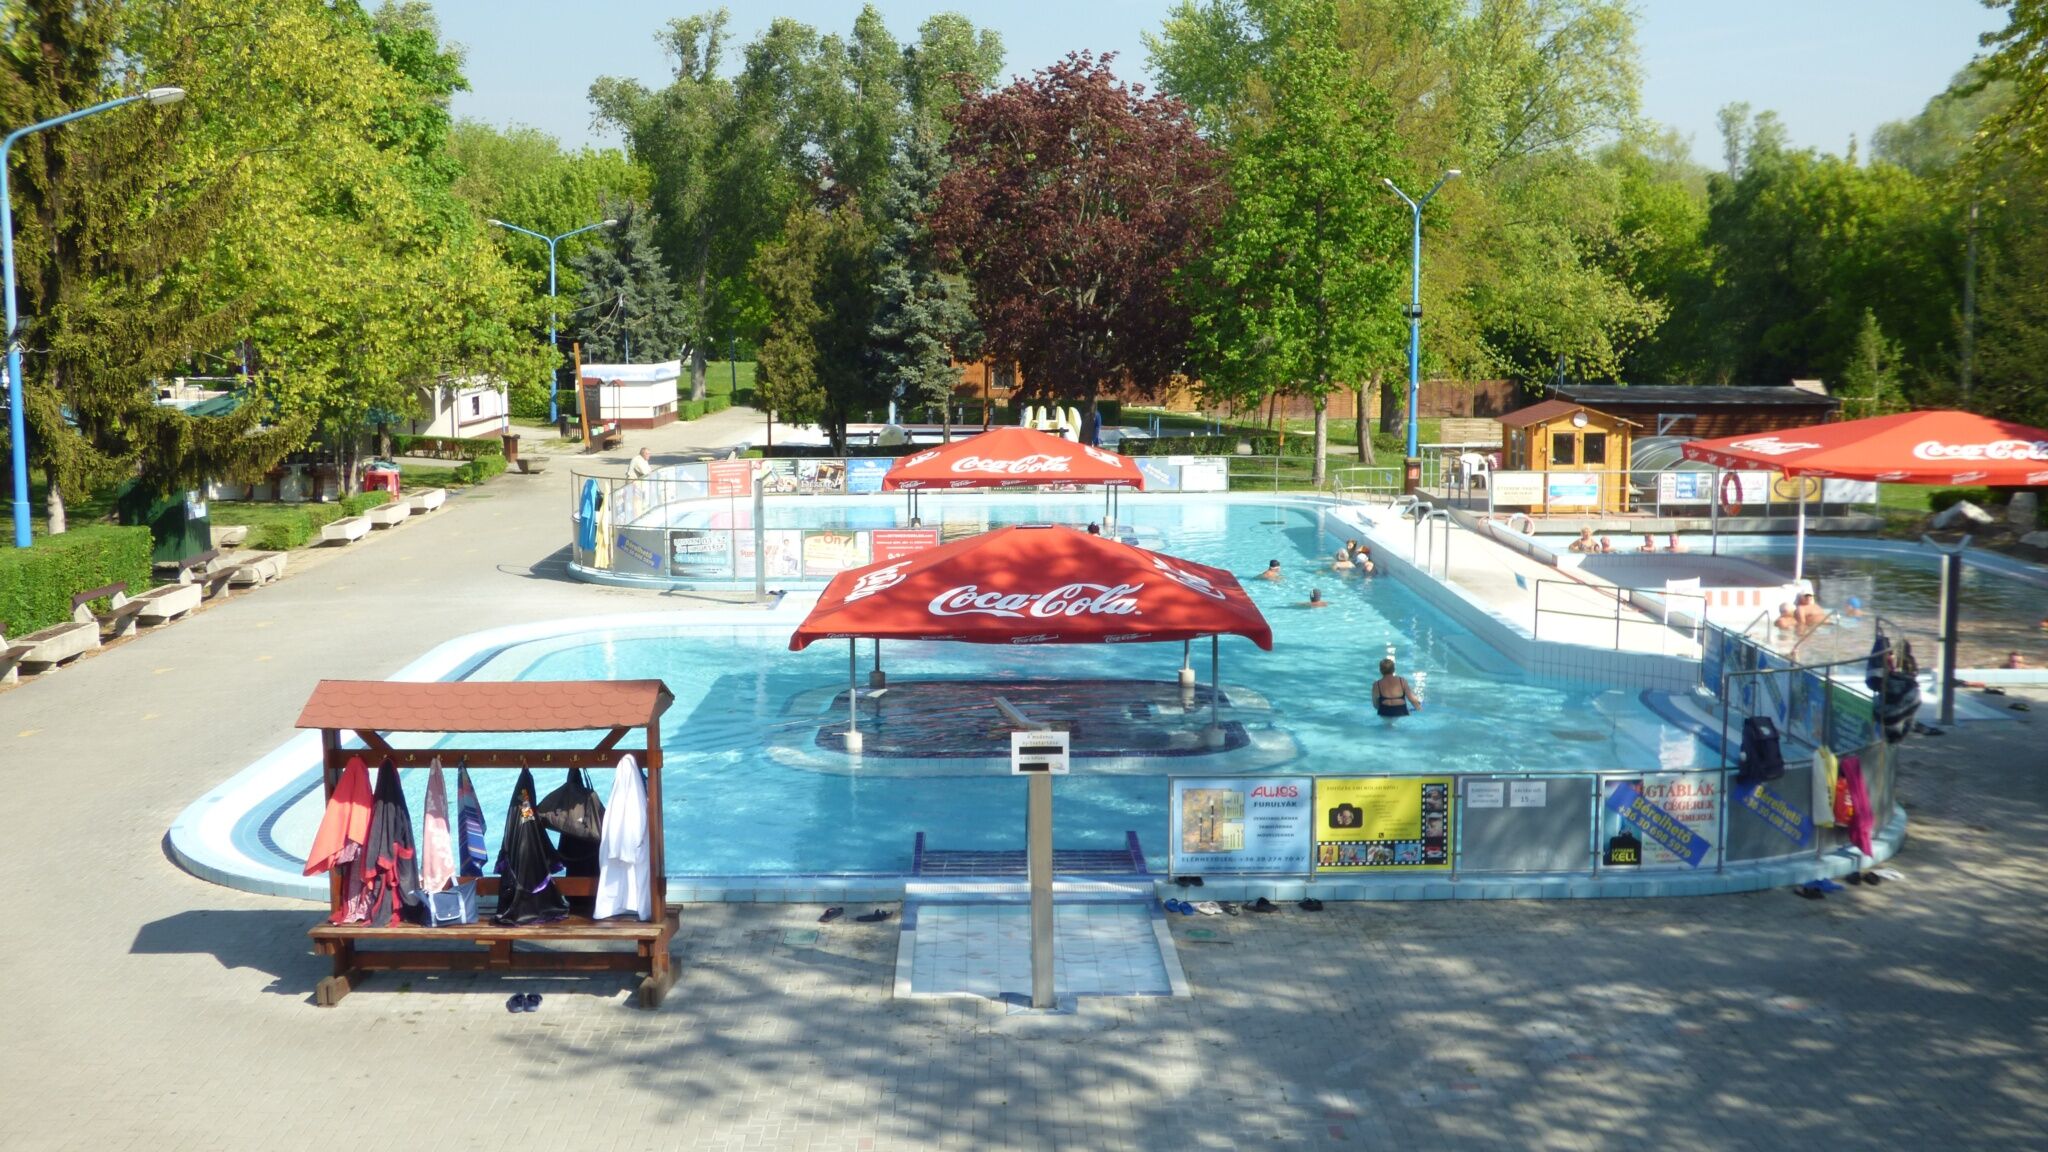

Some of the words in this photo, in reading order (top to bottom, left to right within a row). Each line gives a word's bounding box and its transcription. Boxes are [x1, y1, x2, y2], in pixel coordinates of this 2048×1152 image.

[1913, 440, 2048, 460] Coca-Col
[951, 454, 1072, 474] Coca-Cola
[927, 582, 1144, 618] Coca-Cola
[1645, 780, 1715, 798] GTÁBLÁK
[1632, 797, 1692, 844] Bérelhető
[1612, 852, 1637, 862] KELL
